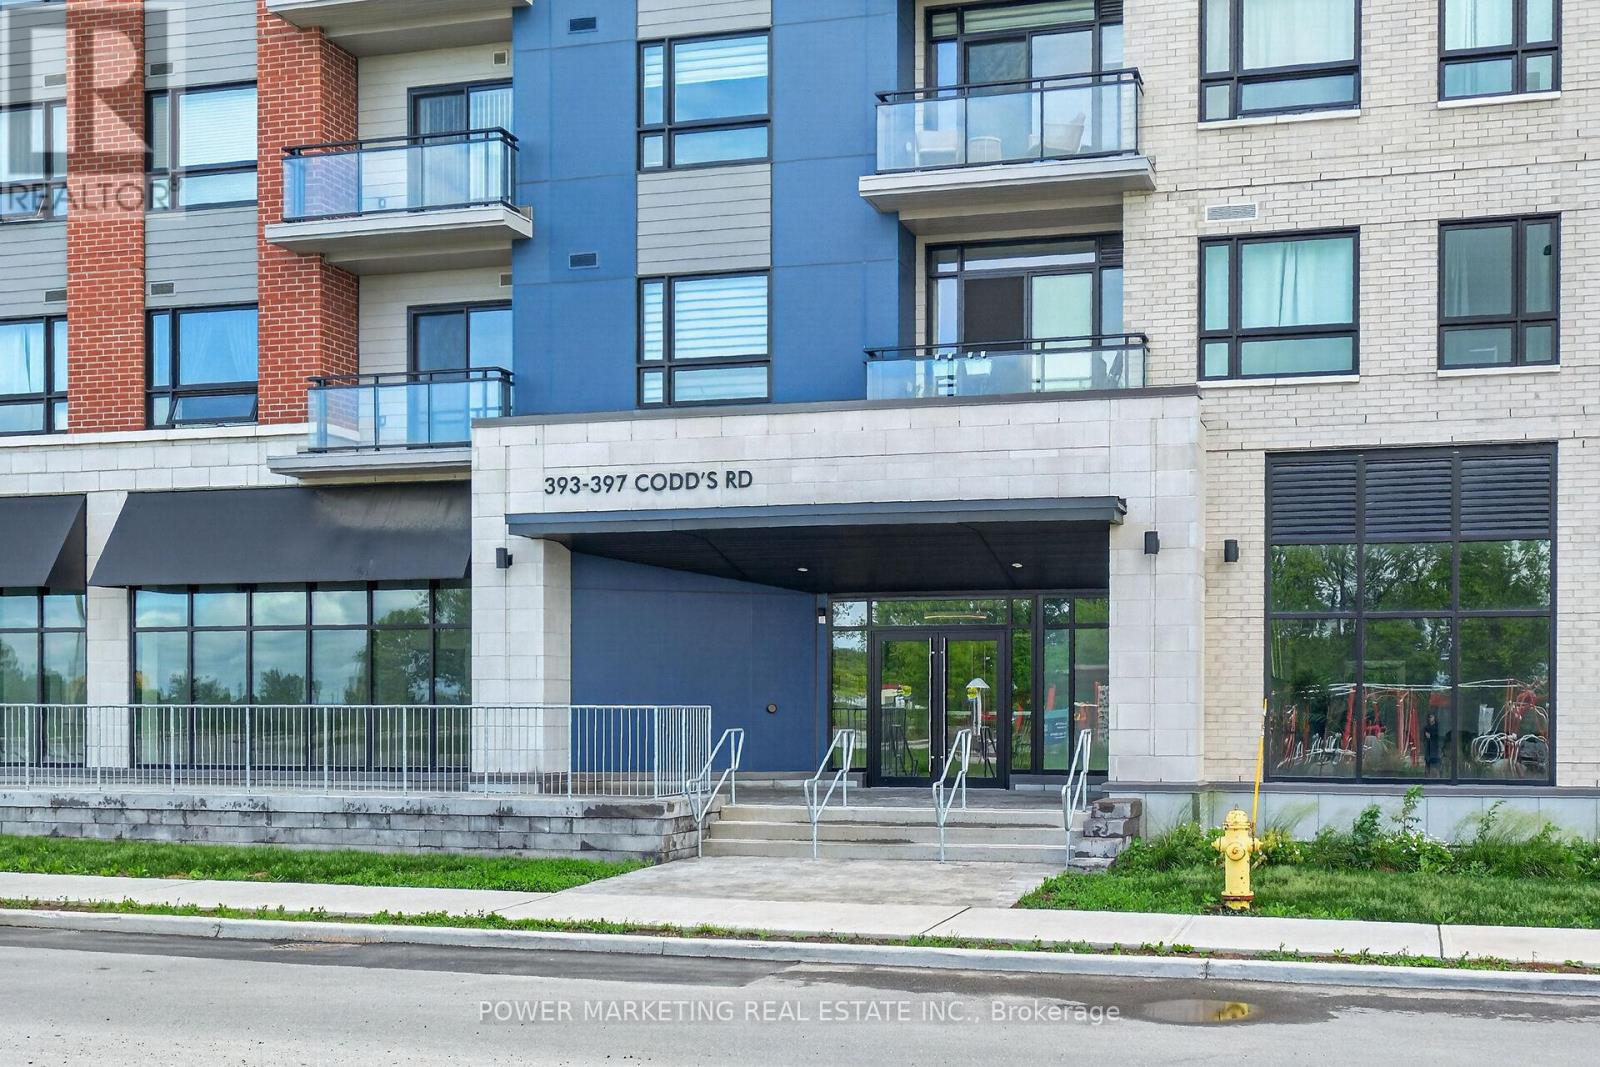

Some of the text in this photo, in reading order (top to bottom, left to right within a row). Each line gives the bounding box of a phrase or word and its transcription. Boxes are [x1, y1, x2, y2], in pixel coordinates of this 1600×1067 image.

[544, 470, 753, 494] 393-397 CODD'S RD
